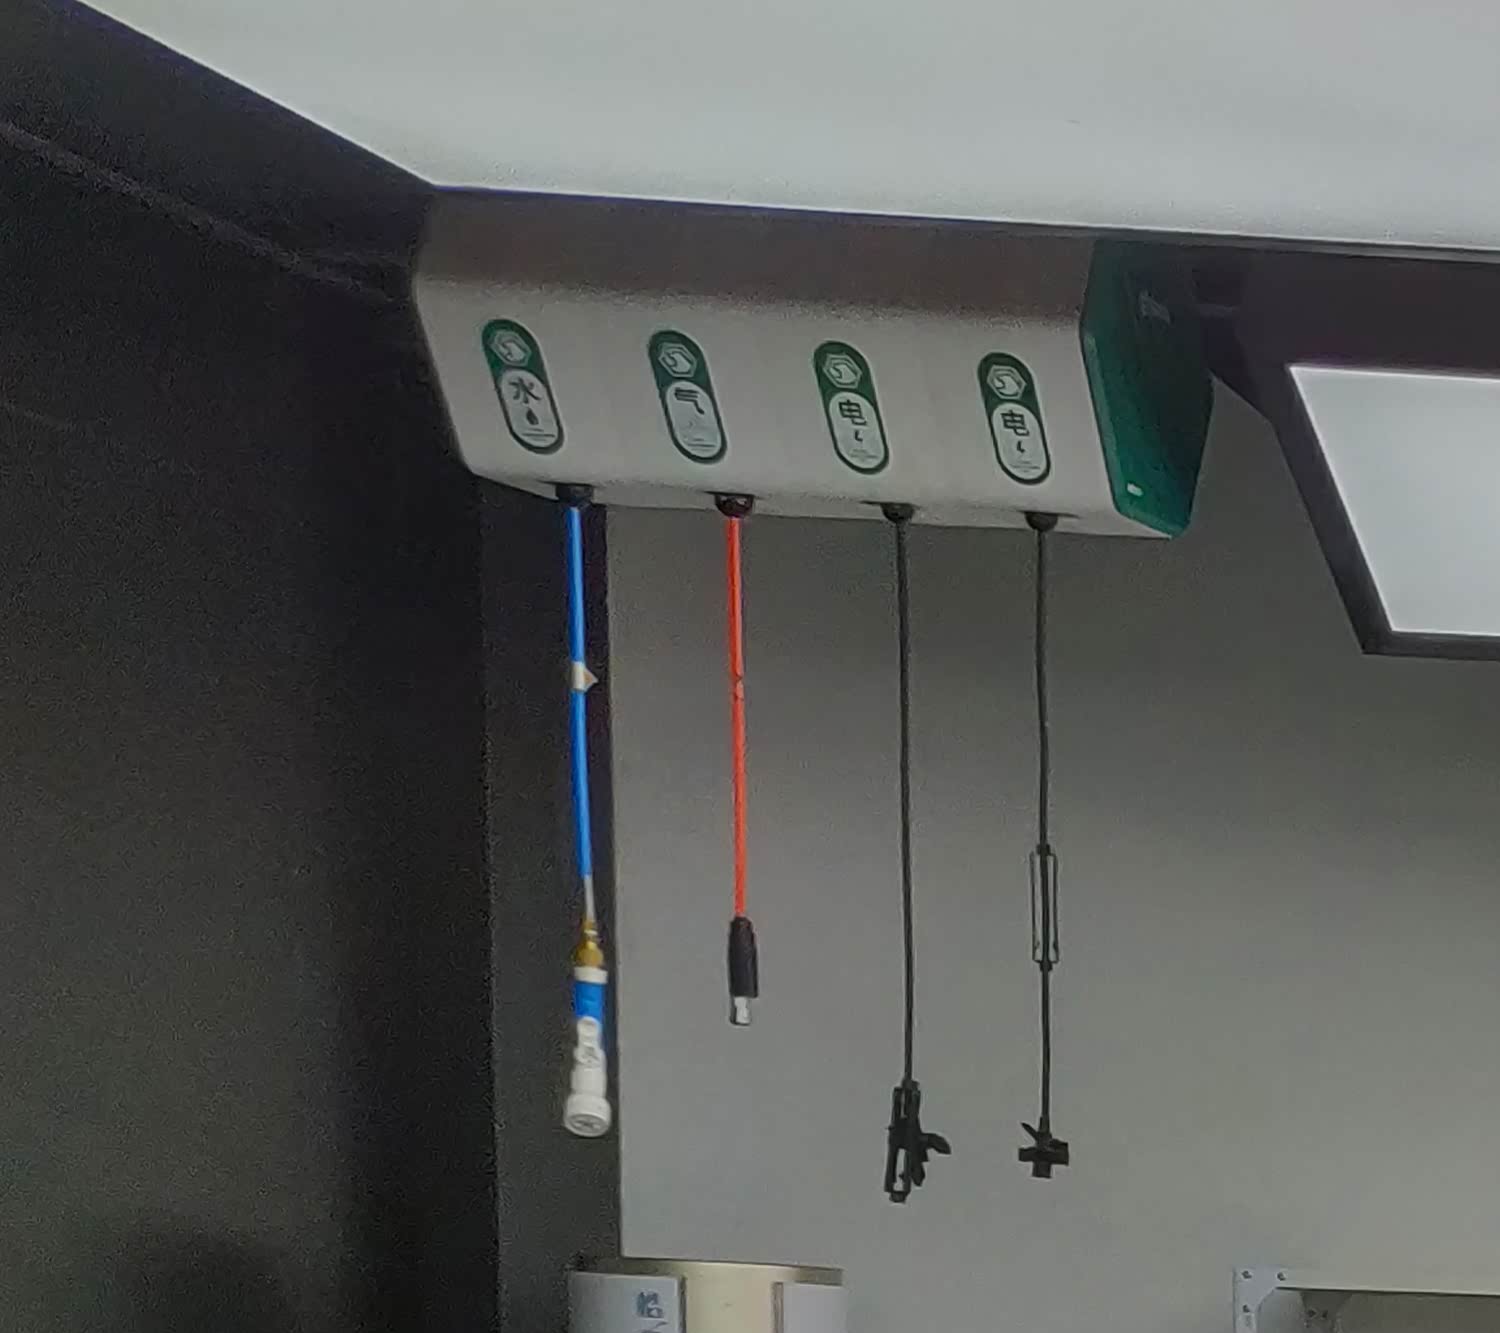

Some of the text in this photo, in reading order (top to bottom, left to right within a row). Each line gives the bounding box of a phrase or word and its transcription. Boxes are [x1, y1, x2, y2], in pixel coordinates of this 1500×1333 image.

[508, 376, 544, 405] 水
[838, 398, 868, 427] 电
[1000, 409, 1031, 437] 电
